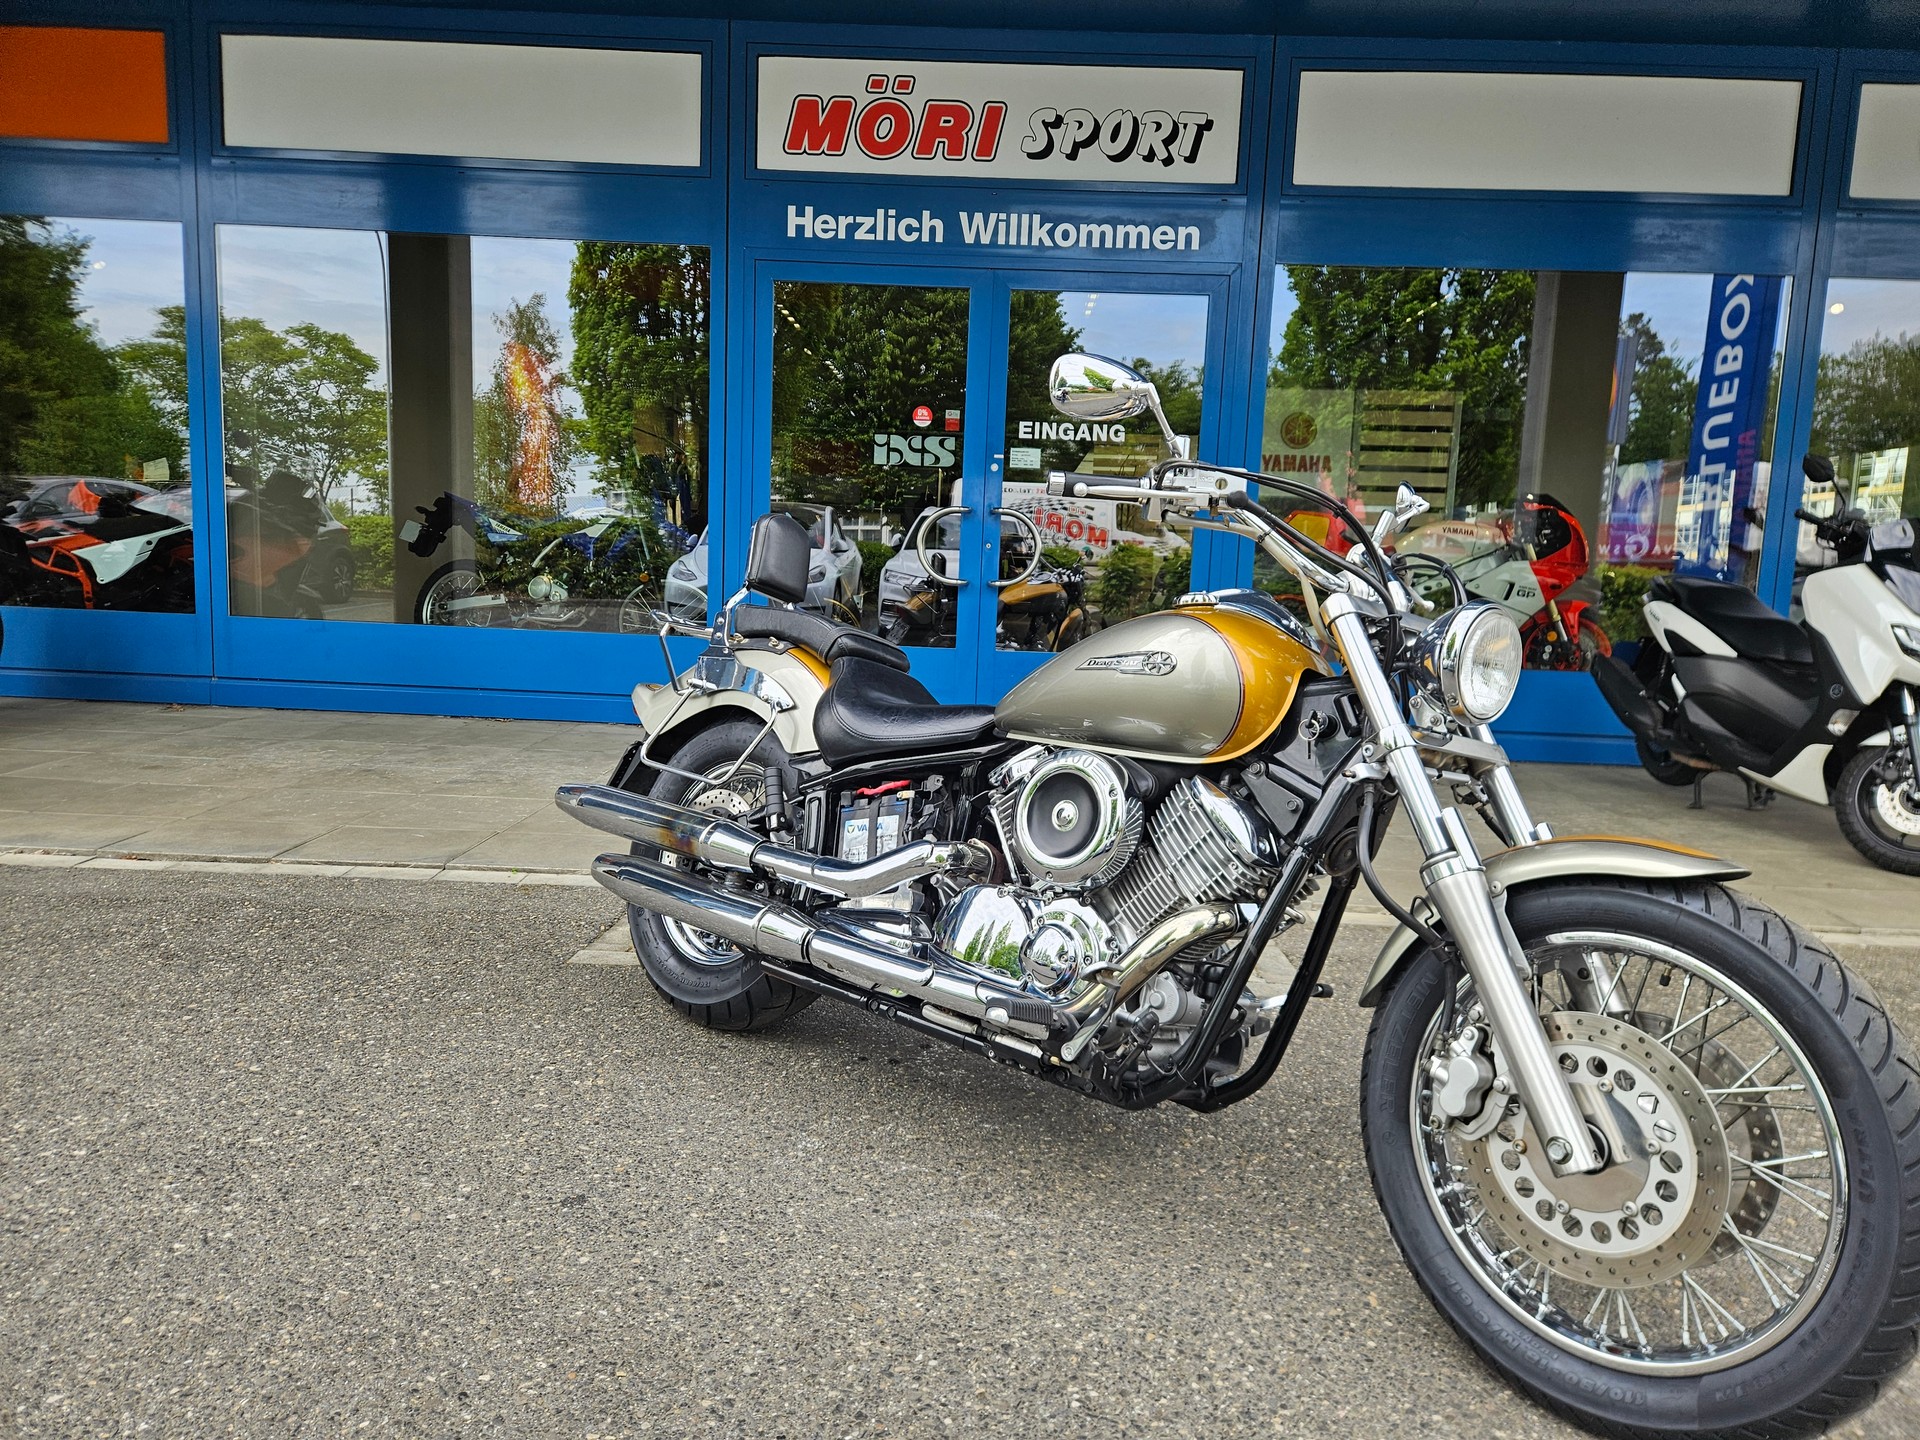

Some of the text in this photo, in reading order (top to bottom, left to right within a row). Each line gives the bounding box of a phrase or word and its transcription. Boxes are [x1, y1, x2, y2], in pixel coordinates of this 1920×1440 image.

[783, 74, 1214, 167] MÖRI SPORT
[786, 205, 1201, 251] Herzlich Willkommen
[1018, 421, 1126, 443] EINGANG
[1262, 454, 1333, 473] YAMAHA
[1442, 526, 1475, 537] YAMAHA
[1517, 589, 1536, 599] GP
[1379, 971, 1439, 1114] METZELER
